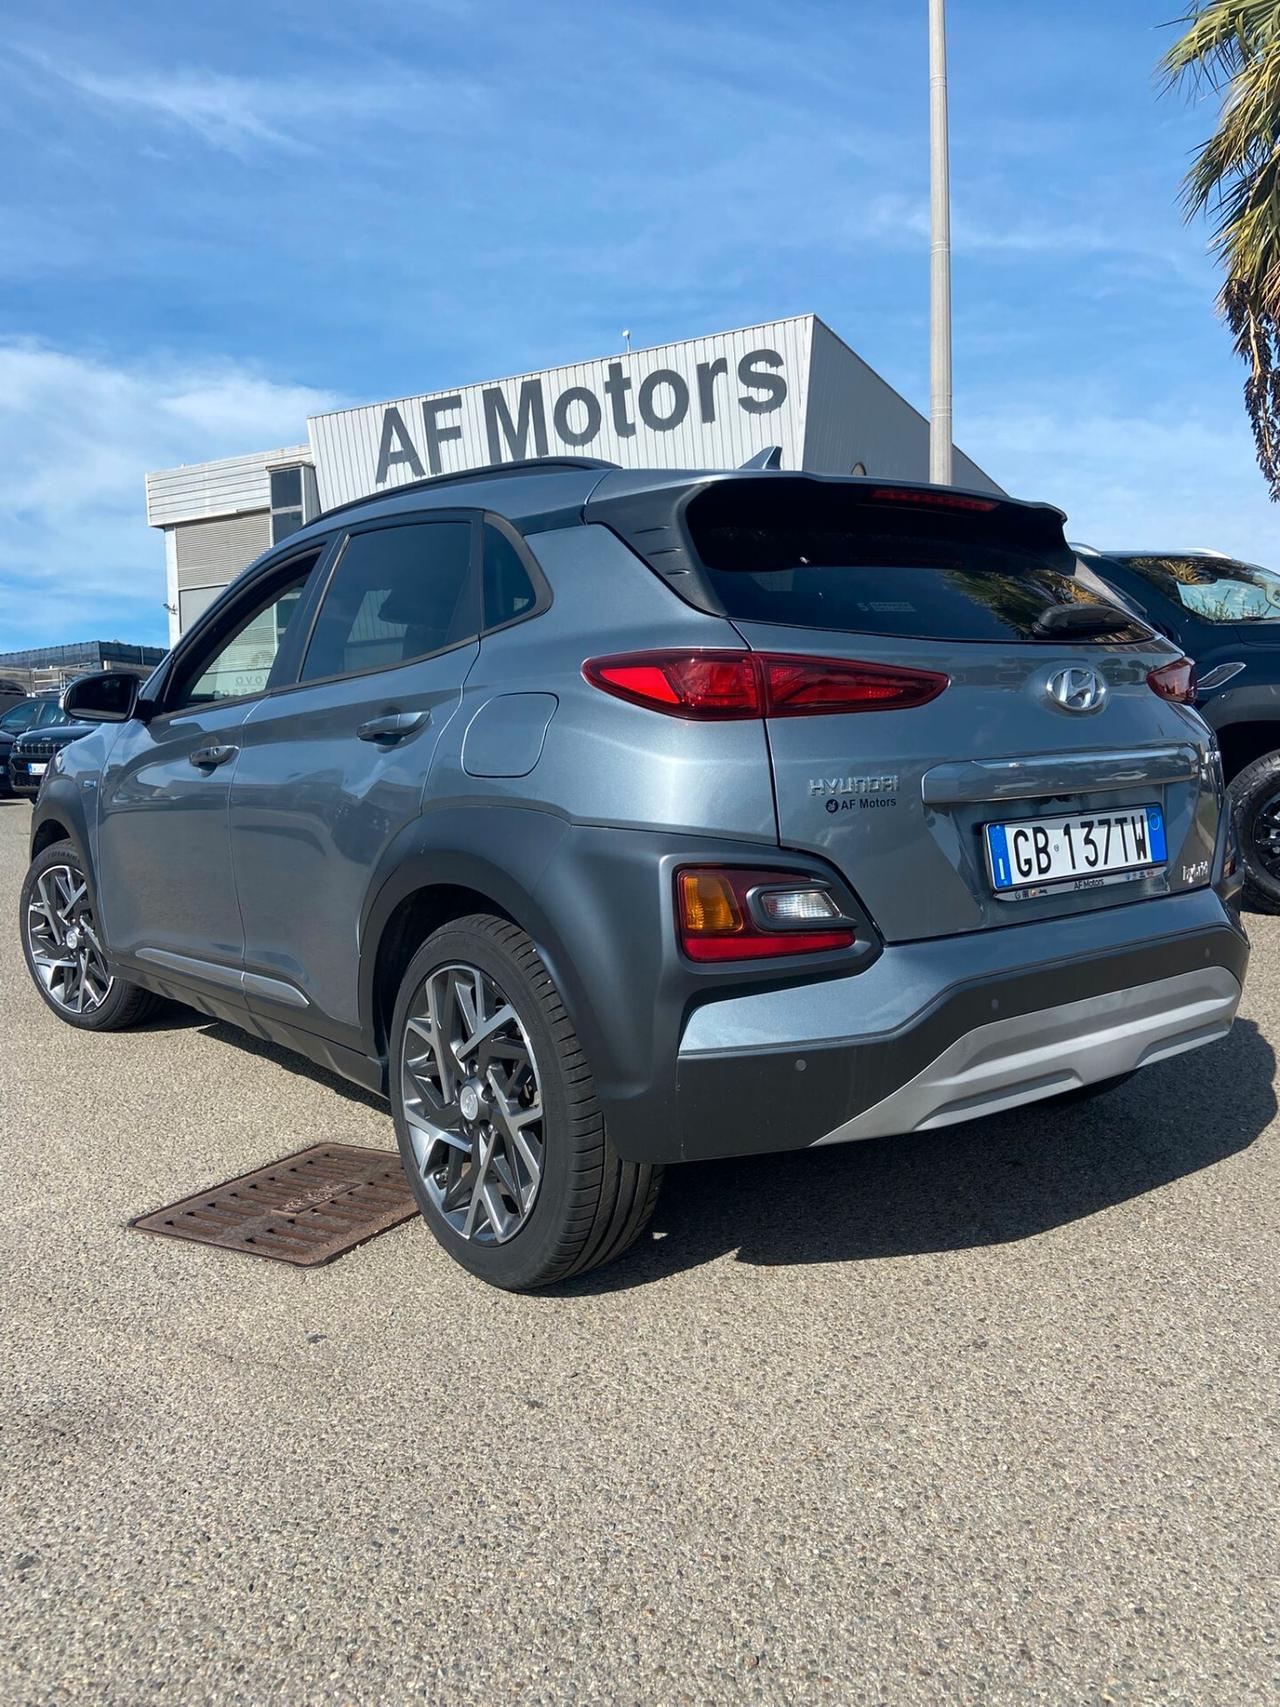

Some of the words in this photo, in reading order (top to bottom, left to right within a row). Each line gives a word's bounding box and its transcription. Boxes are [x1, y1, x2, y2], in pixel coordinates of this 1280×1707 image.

[375, 394, 463, 484] AF
[482, 348, 788, 465] Motors
[841, 799, 856, 811] AF
[859, 797, 897, 809] Motors
[1013, 826, 1052, 878] GB
[1063, 815, 1148, 869] 137TW
[1074, 879, 1083, 890] AF
[1083, 877, 1105, 888] Motors
